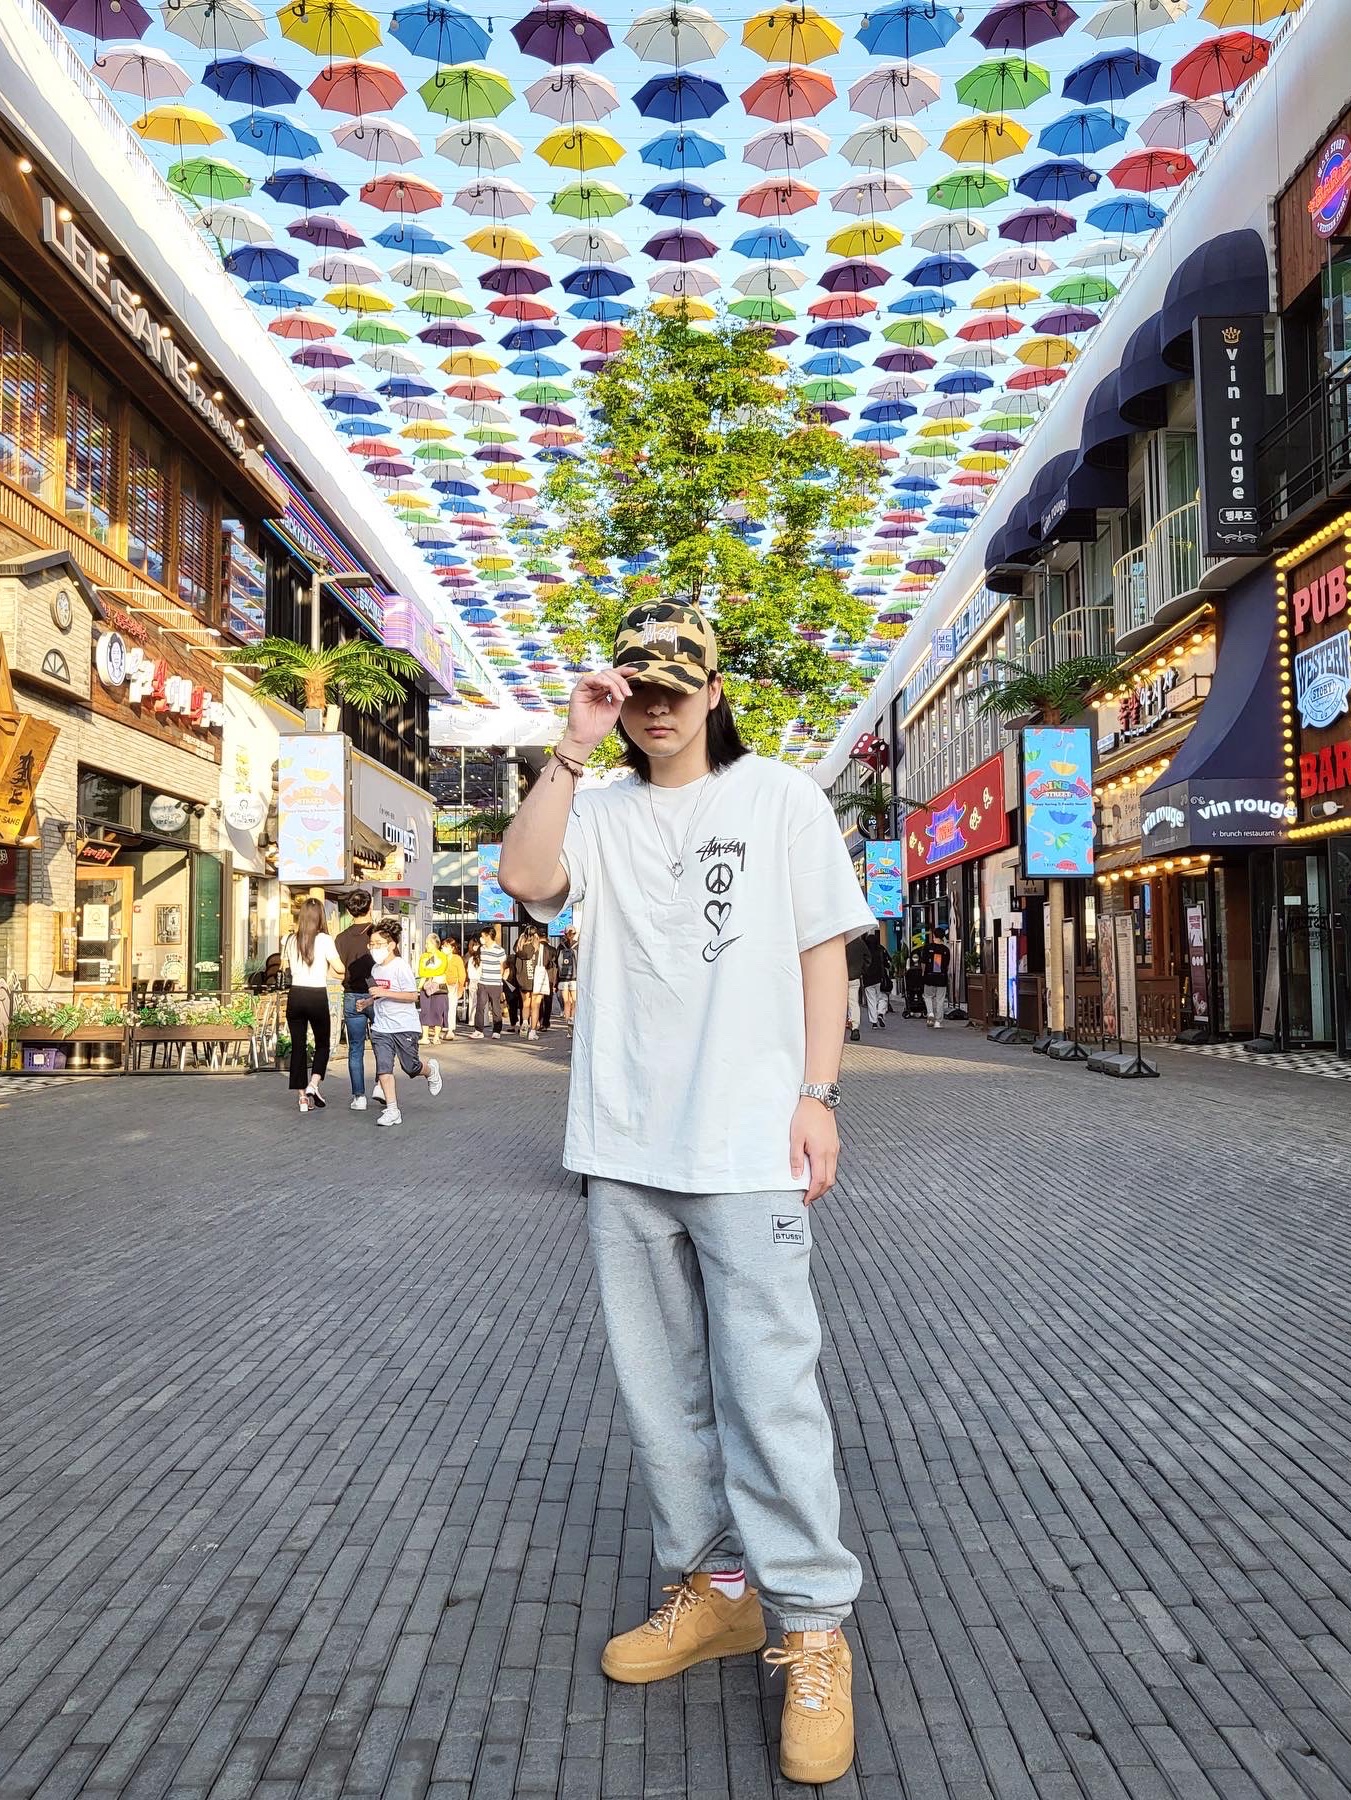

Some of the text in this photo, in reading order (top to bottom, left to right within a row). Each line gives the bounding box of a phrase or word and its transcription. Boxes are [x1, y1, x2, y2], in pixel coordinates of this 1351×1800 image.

[110, 279, 191, 398] SANG
[1225, 348, 1245, 500] vin rouge
[1293, 565, 1347, 636] PUB
[1297, 634, 1350, 700] WESTERN
[1312, 682, 1332, 699] STORY
[1299, 741, 1351, 799] BAR
[1156, 805, 1185, 828] rouge
[1197, 799, 1297, 820] vin rouge
[775, 1233, 802, 1241] STUSSY
